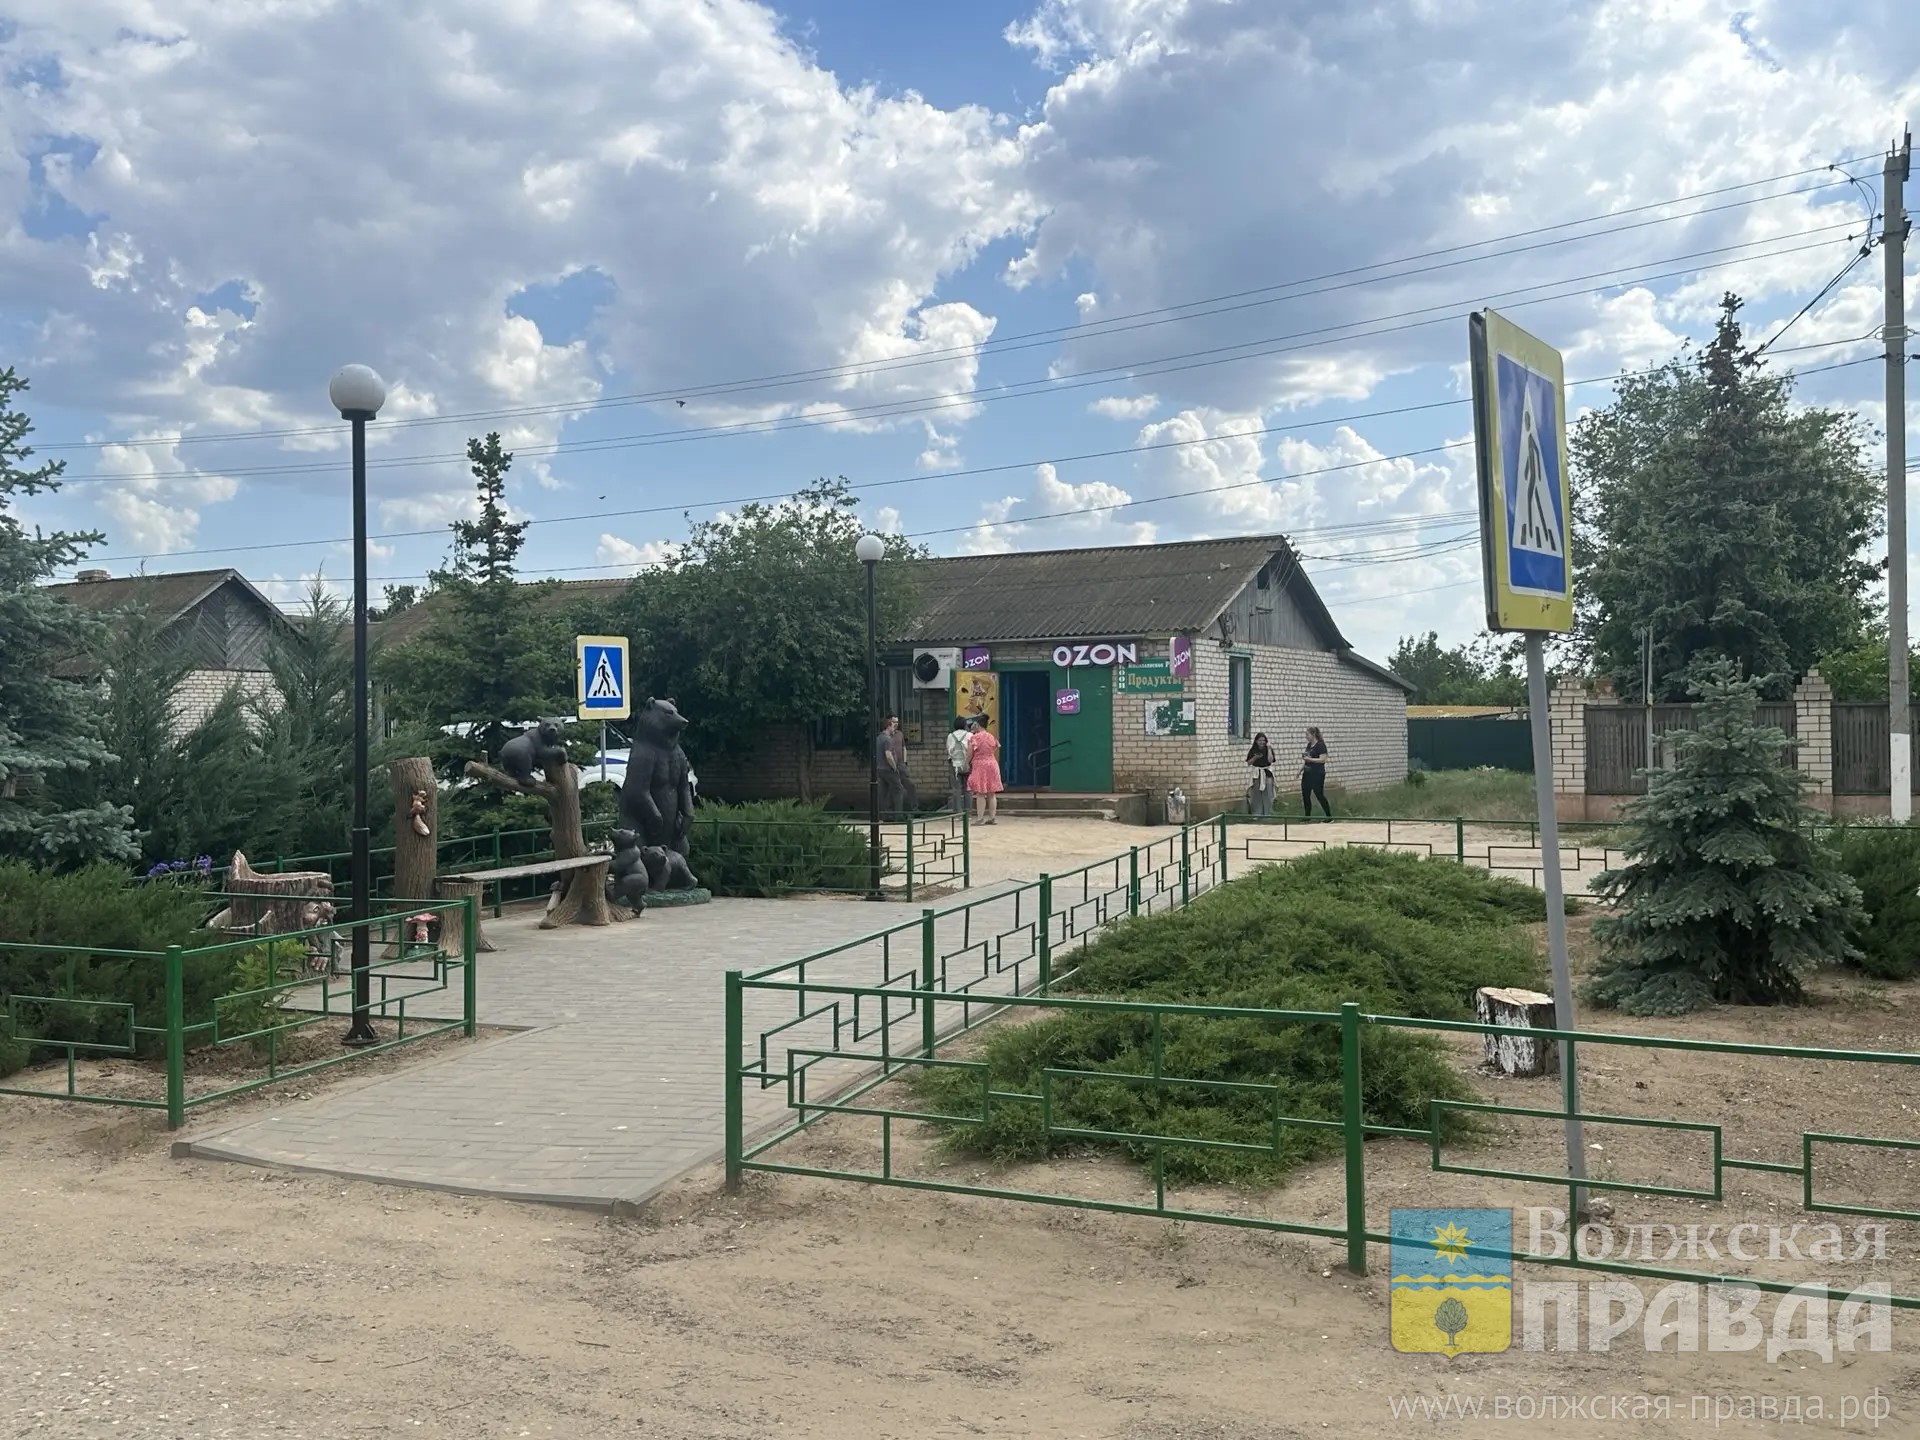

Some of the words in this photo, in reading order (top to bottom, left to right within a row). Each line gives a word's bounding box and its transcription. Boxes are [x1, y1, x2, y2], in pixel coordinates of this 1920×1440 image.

[1054, 644, 1135, 666] OZON
[1128, 673, 1181, 689] Продукты
[1056, 692, 1079, 706] OZON
